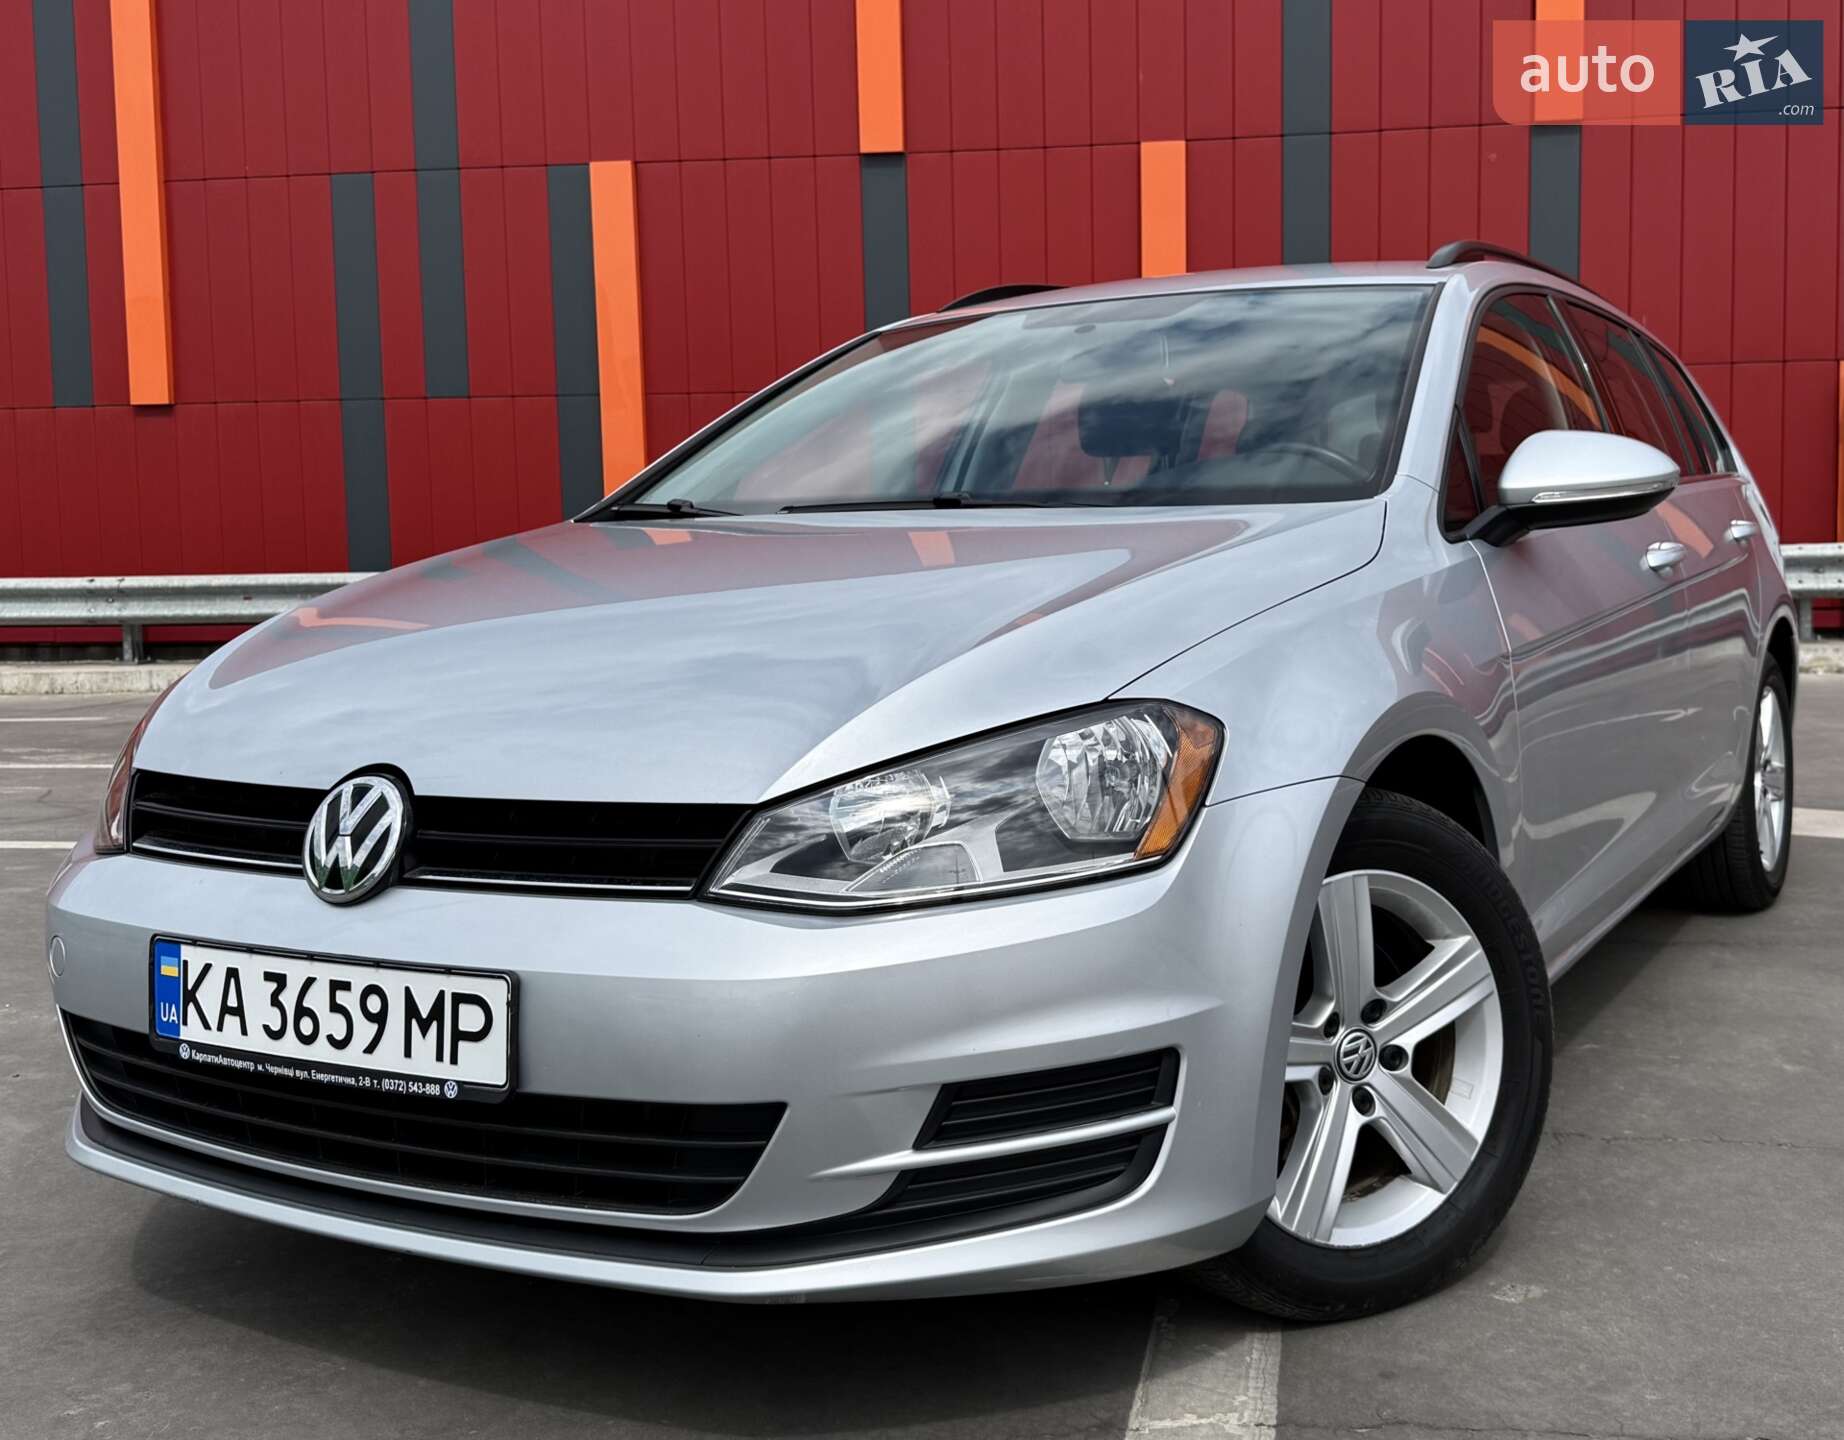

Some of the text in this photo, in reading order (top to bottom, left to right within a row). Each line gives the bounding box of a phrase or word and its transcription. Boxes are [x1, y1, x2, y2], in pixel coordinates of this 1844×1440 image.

[160, 1001, 179, 1024] UA
[182, 960, 493, 1065] KA 3659 MP
[191, 1049, 254, 1072] КарпатиАвтоцентр
[265, 1063, 294, 1077] Чернівці
[295, 1070, 310, 1080] вул.
[311, 1069, 357, 1087] Енергетична,
[381, 1079, 406, 1094] (0372)
[408, 1082, 440, 1096] 543-888
